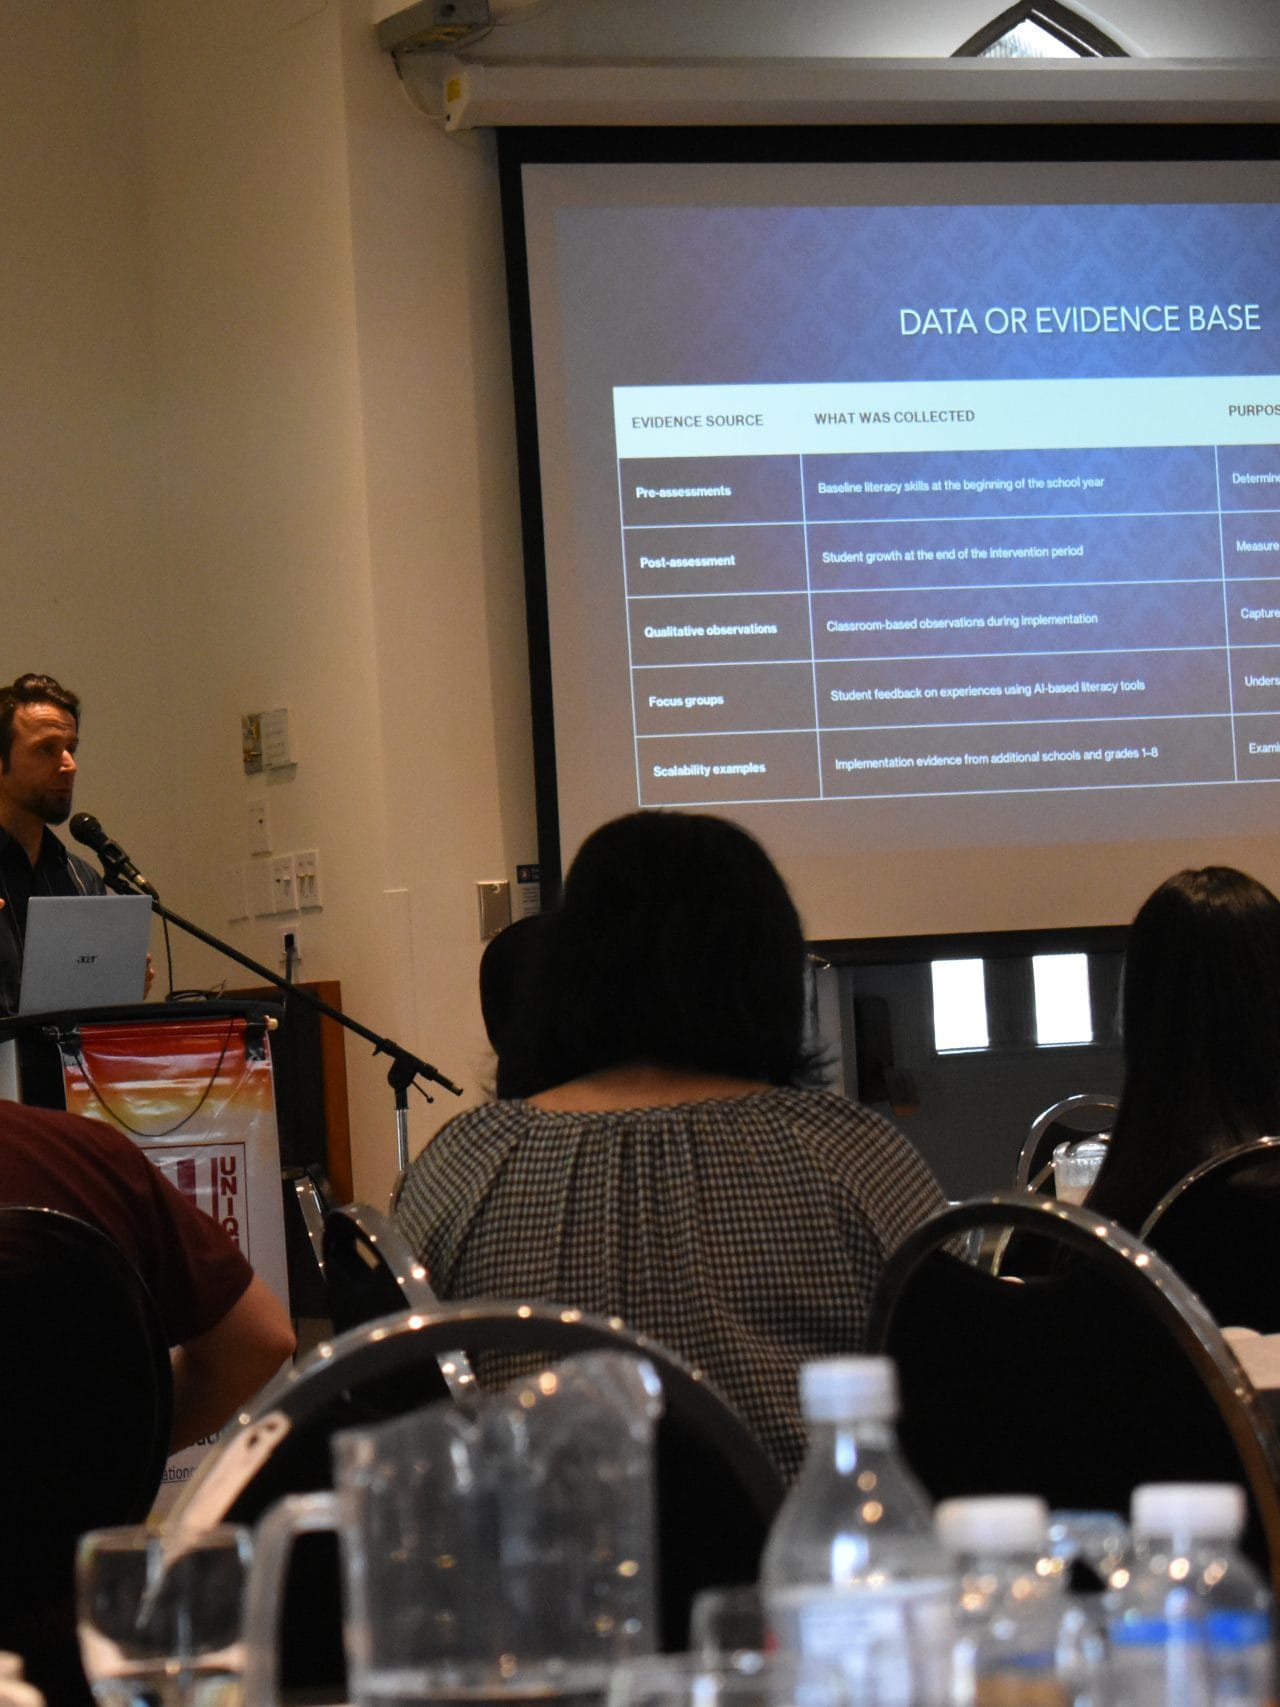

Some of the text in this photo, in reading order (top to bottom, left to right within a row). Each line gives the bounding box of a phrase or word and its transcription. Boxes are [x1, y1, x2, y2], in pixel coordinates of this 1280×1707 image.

[900, 304, 1261, 335] DATA OR EVIDENCE BASE
[632, 414, 763, 428] EVIDENCE SOURCE
[814, 410, 975, 425] WHAT WAS COLLECTED
[636, 485, 732, 499] Pre-assessments
[818, 476, 1105, 495] Baseline literacy skills at the beginning of the school year
[1236, 540, 1280, 552] Measure
[640, 554, 736, 569] Post-assessment
[822, 545, 1084, 565] Student growth at the end of the intervention period
[644, 622, 778, 638] Qualitative observations
[826, 613, 1098, 632] Classroom-based observations during implementation
[830, 680, 1145, 702] Student feedback on experiences using AI-based literacy tools
[648, 694, 725, 708] Focus groups
[835, 757, 914, 772] Implementation
[916, 755, 962, 767] evidence
[964, 754, 989, 765] from
[991, 751, 1040, 764] additional
[1042, 750, 1081, 762] schools
[1083, 749, 1102, 760] and
[1104, 748, 1139, 762] grades
[653, 762, 766, 777] Scalability examples
